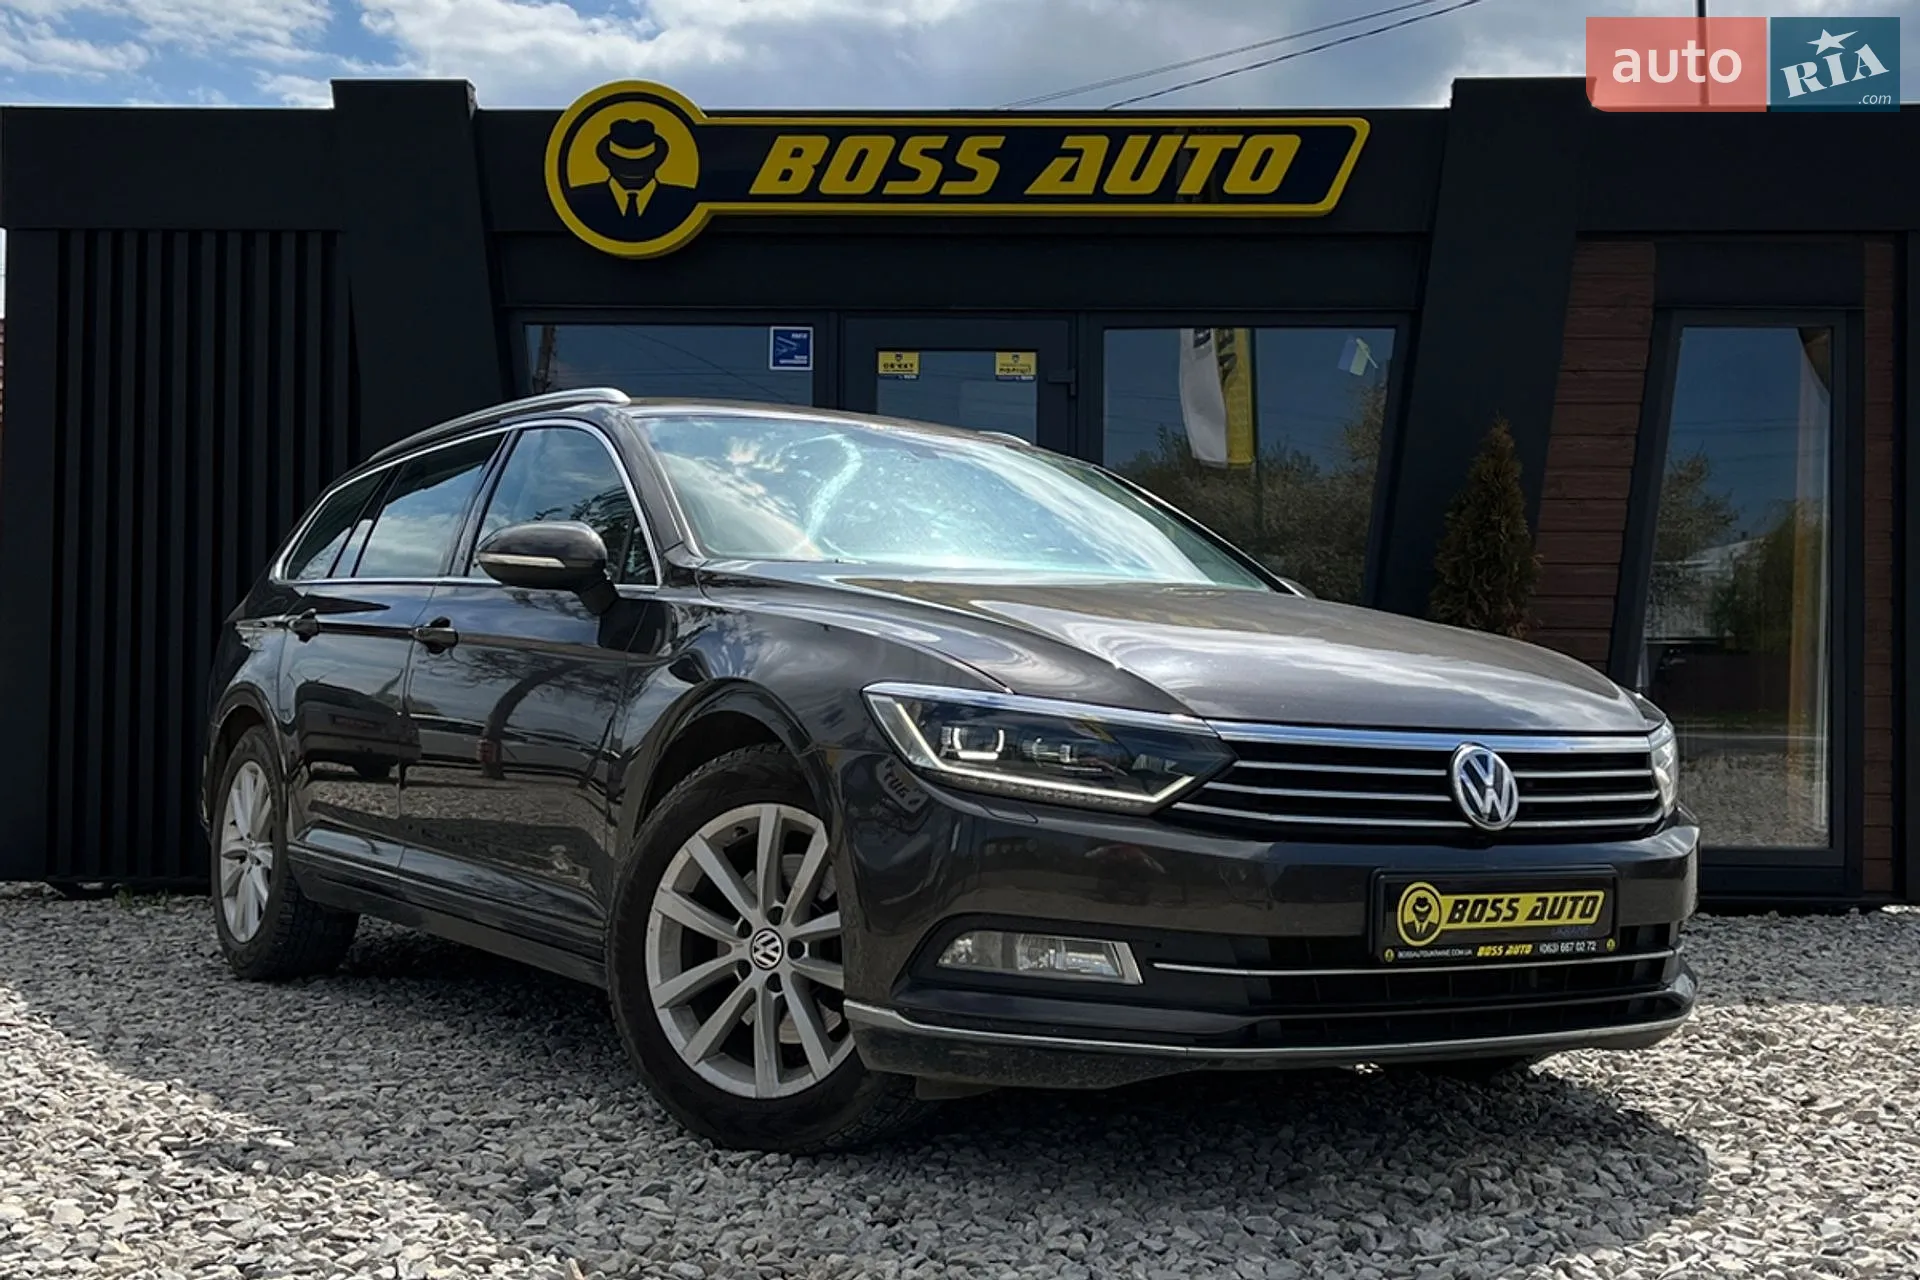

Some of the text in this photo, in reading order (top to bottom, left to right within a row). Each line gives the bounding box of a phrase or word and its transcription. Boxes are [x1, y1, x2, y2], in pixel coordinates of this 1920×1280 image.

[749, 135, 1301, 195] BOSS AUTO
[1447, 895, 1600, 924] BOSS AUTO
